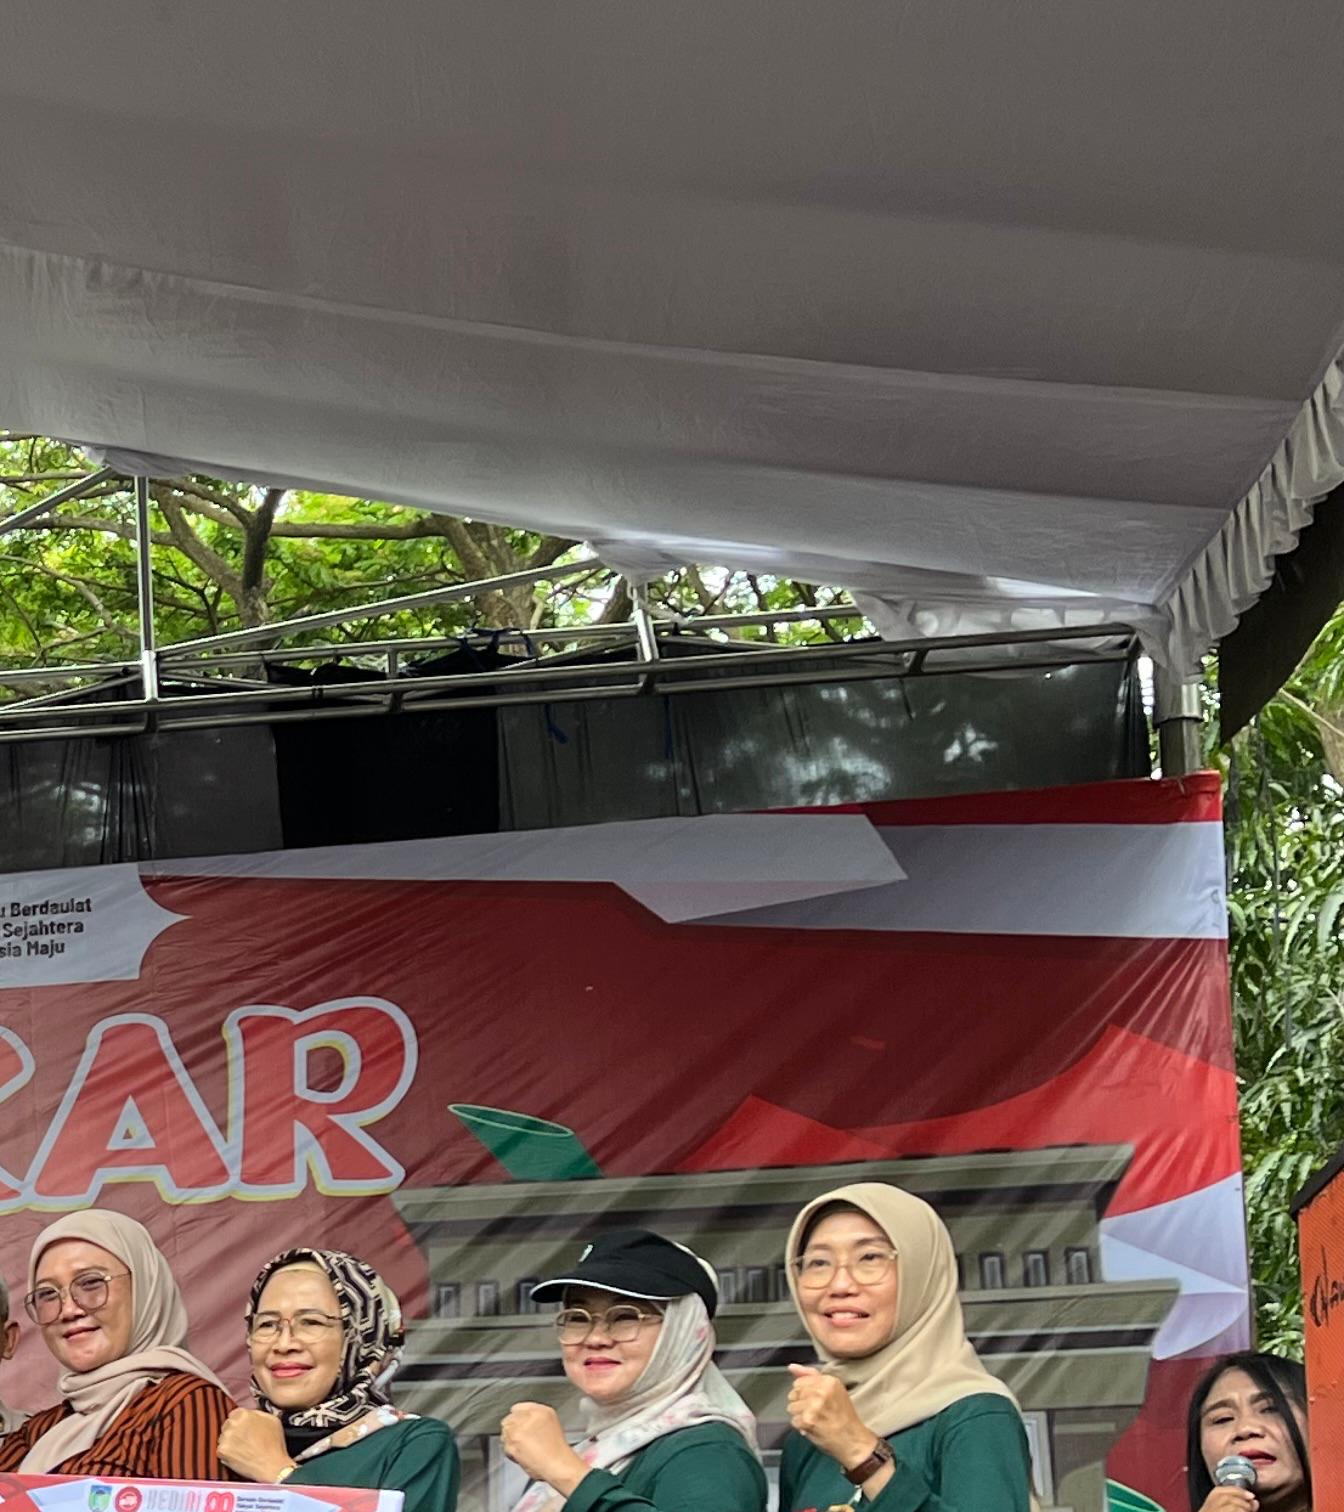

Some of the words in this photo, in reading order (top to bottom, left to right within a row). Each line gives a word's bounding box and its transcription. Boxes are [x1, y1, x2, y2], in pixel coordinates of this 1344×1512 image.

[10, 898, 92, 917] Berdaulat
[2, 920, 84, 941] Sejahtera
[27, 939, 65, 958] Maju
